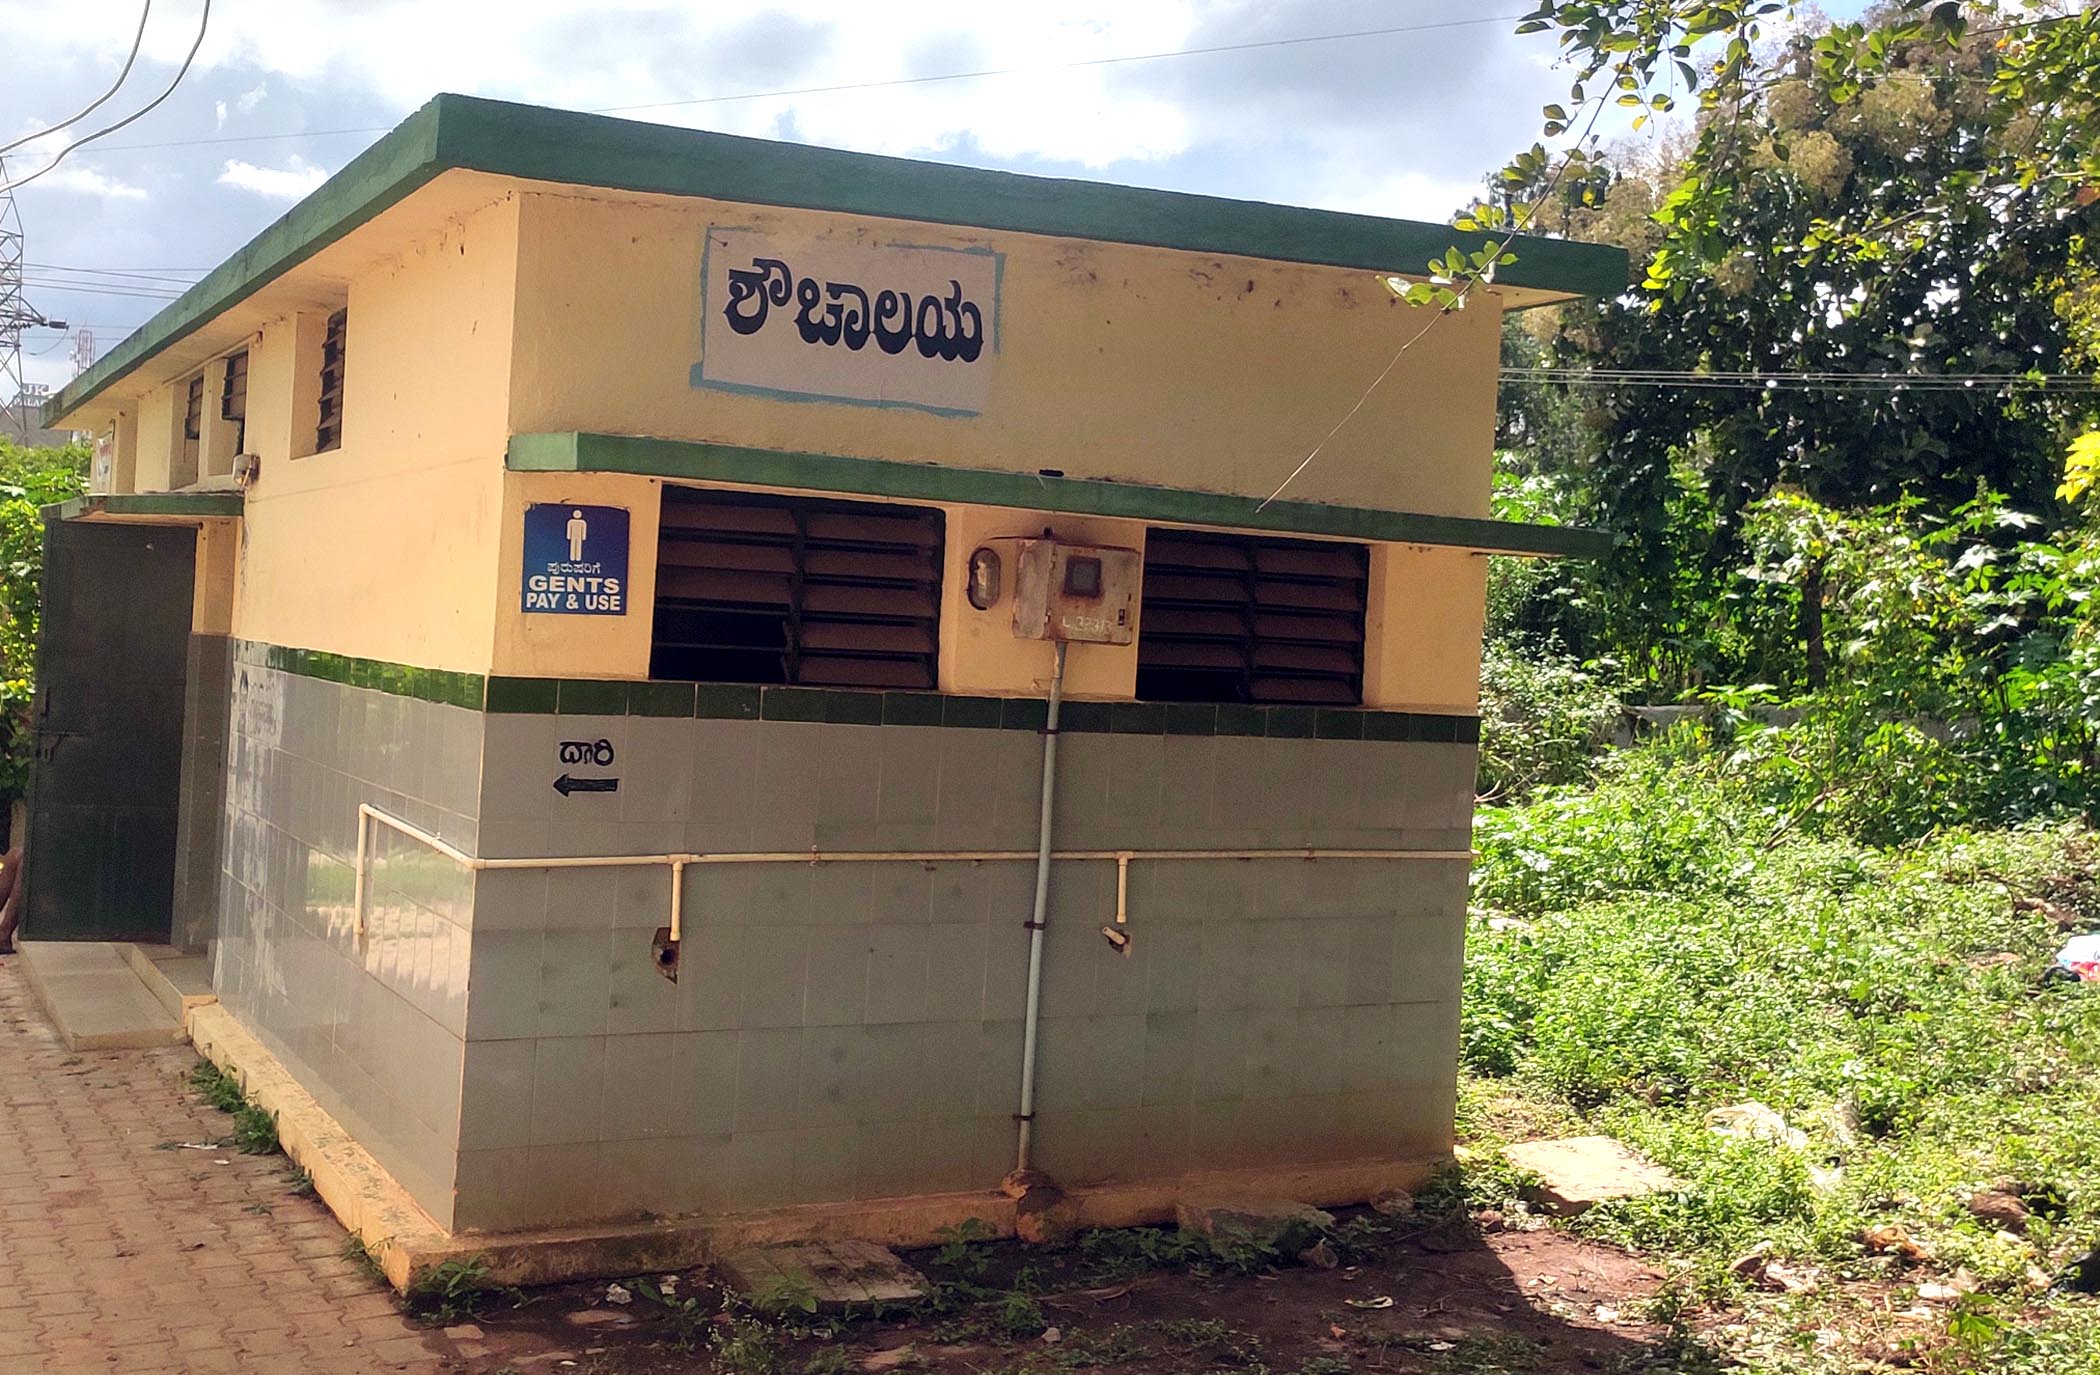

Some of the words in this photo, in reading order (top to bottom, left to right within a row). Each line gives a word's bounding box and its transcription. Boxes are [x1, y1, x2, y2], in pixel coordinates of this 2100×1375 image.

[723, 257, 984, 363] ಶೌಚಾಲಯ
[547, 561, 601, 575] ಪುರುಷರಿಗೆ
[528, 575, 620, 594] GENTS
[526, 592, 560, 609] PAY
[566, 594, 579, 609] &
[585, 594, 621, 611] USE
[560, 738, 614, 766] ದಾರಿ
